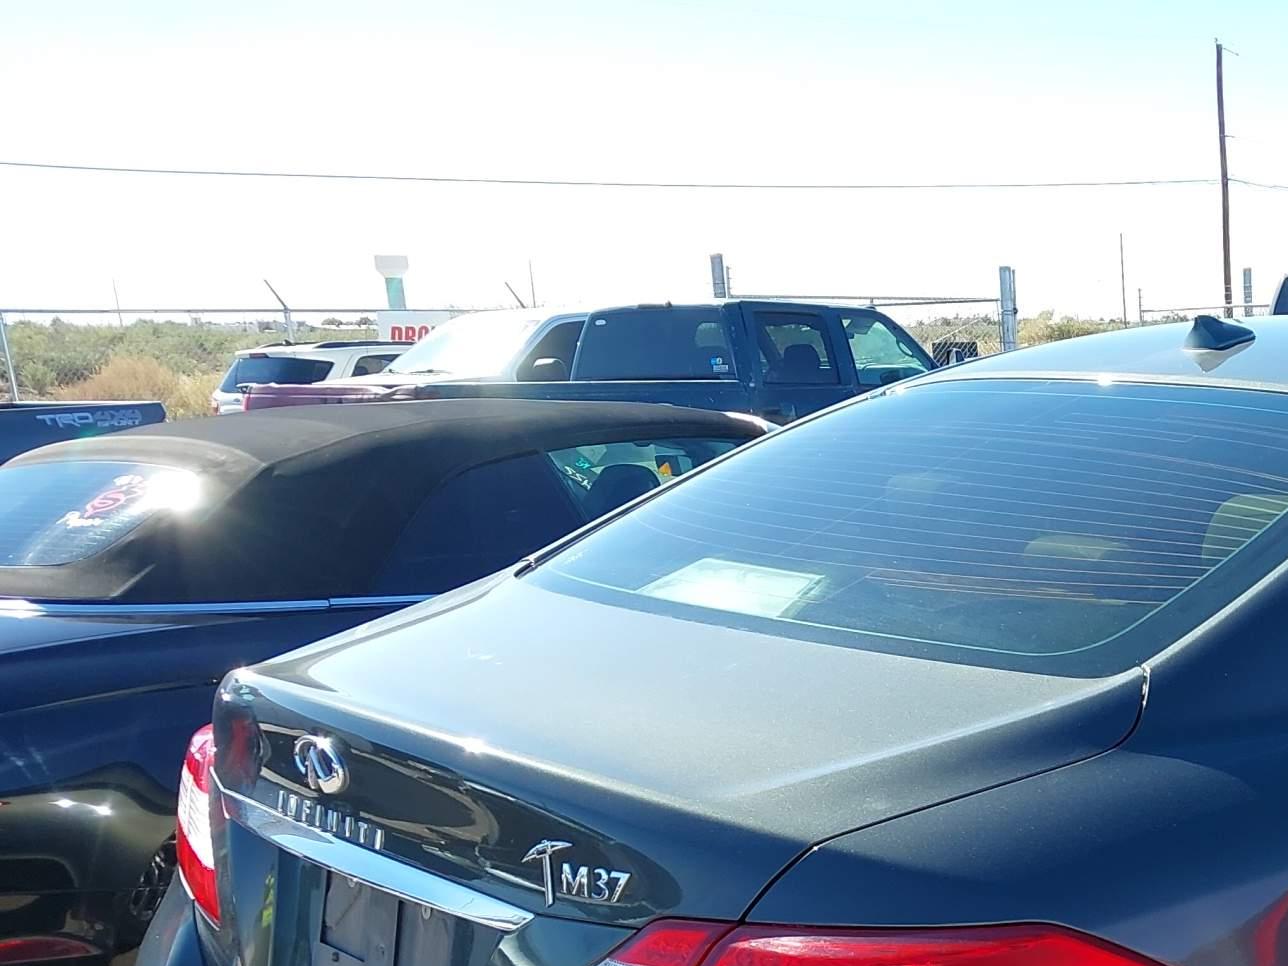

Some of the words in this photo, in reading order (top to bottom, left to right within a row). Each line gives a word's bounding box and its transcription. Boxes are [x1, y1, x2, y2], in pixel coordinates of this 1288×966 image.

[390, 325, 434, 342] DRO
[36, 412, 94, 428] TRD
[277, 790, 385, 850] INFINITI
[561, 862, 632, 903] M37
